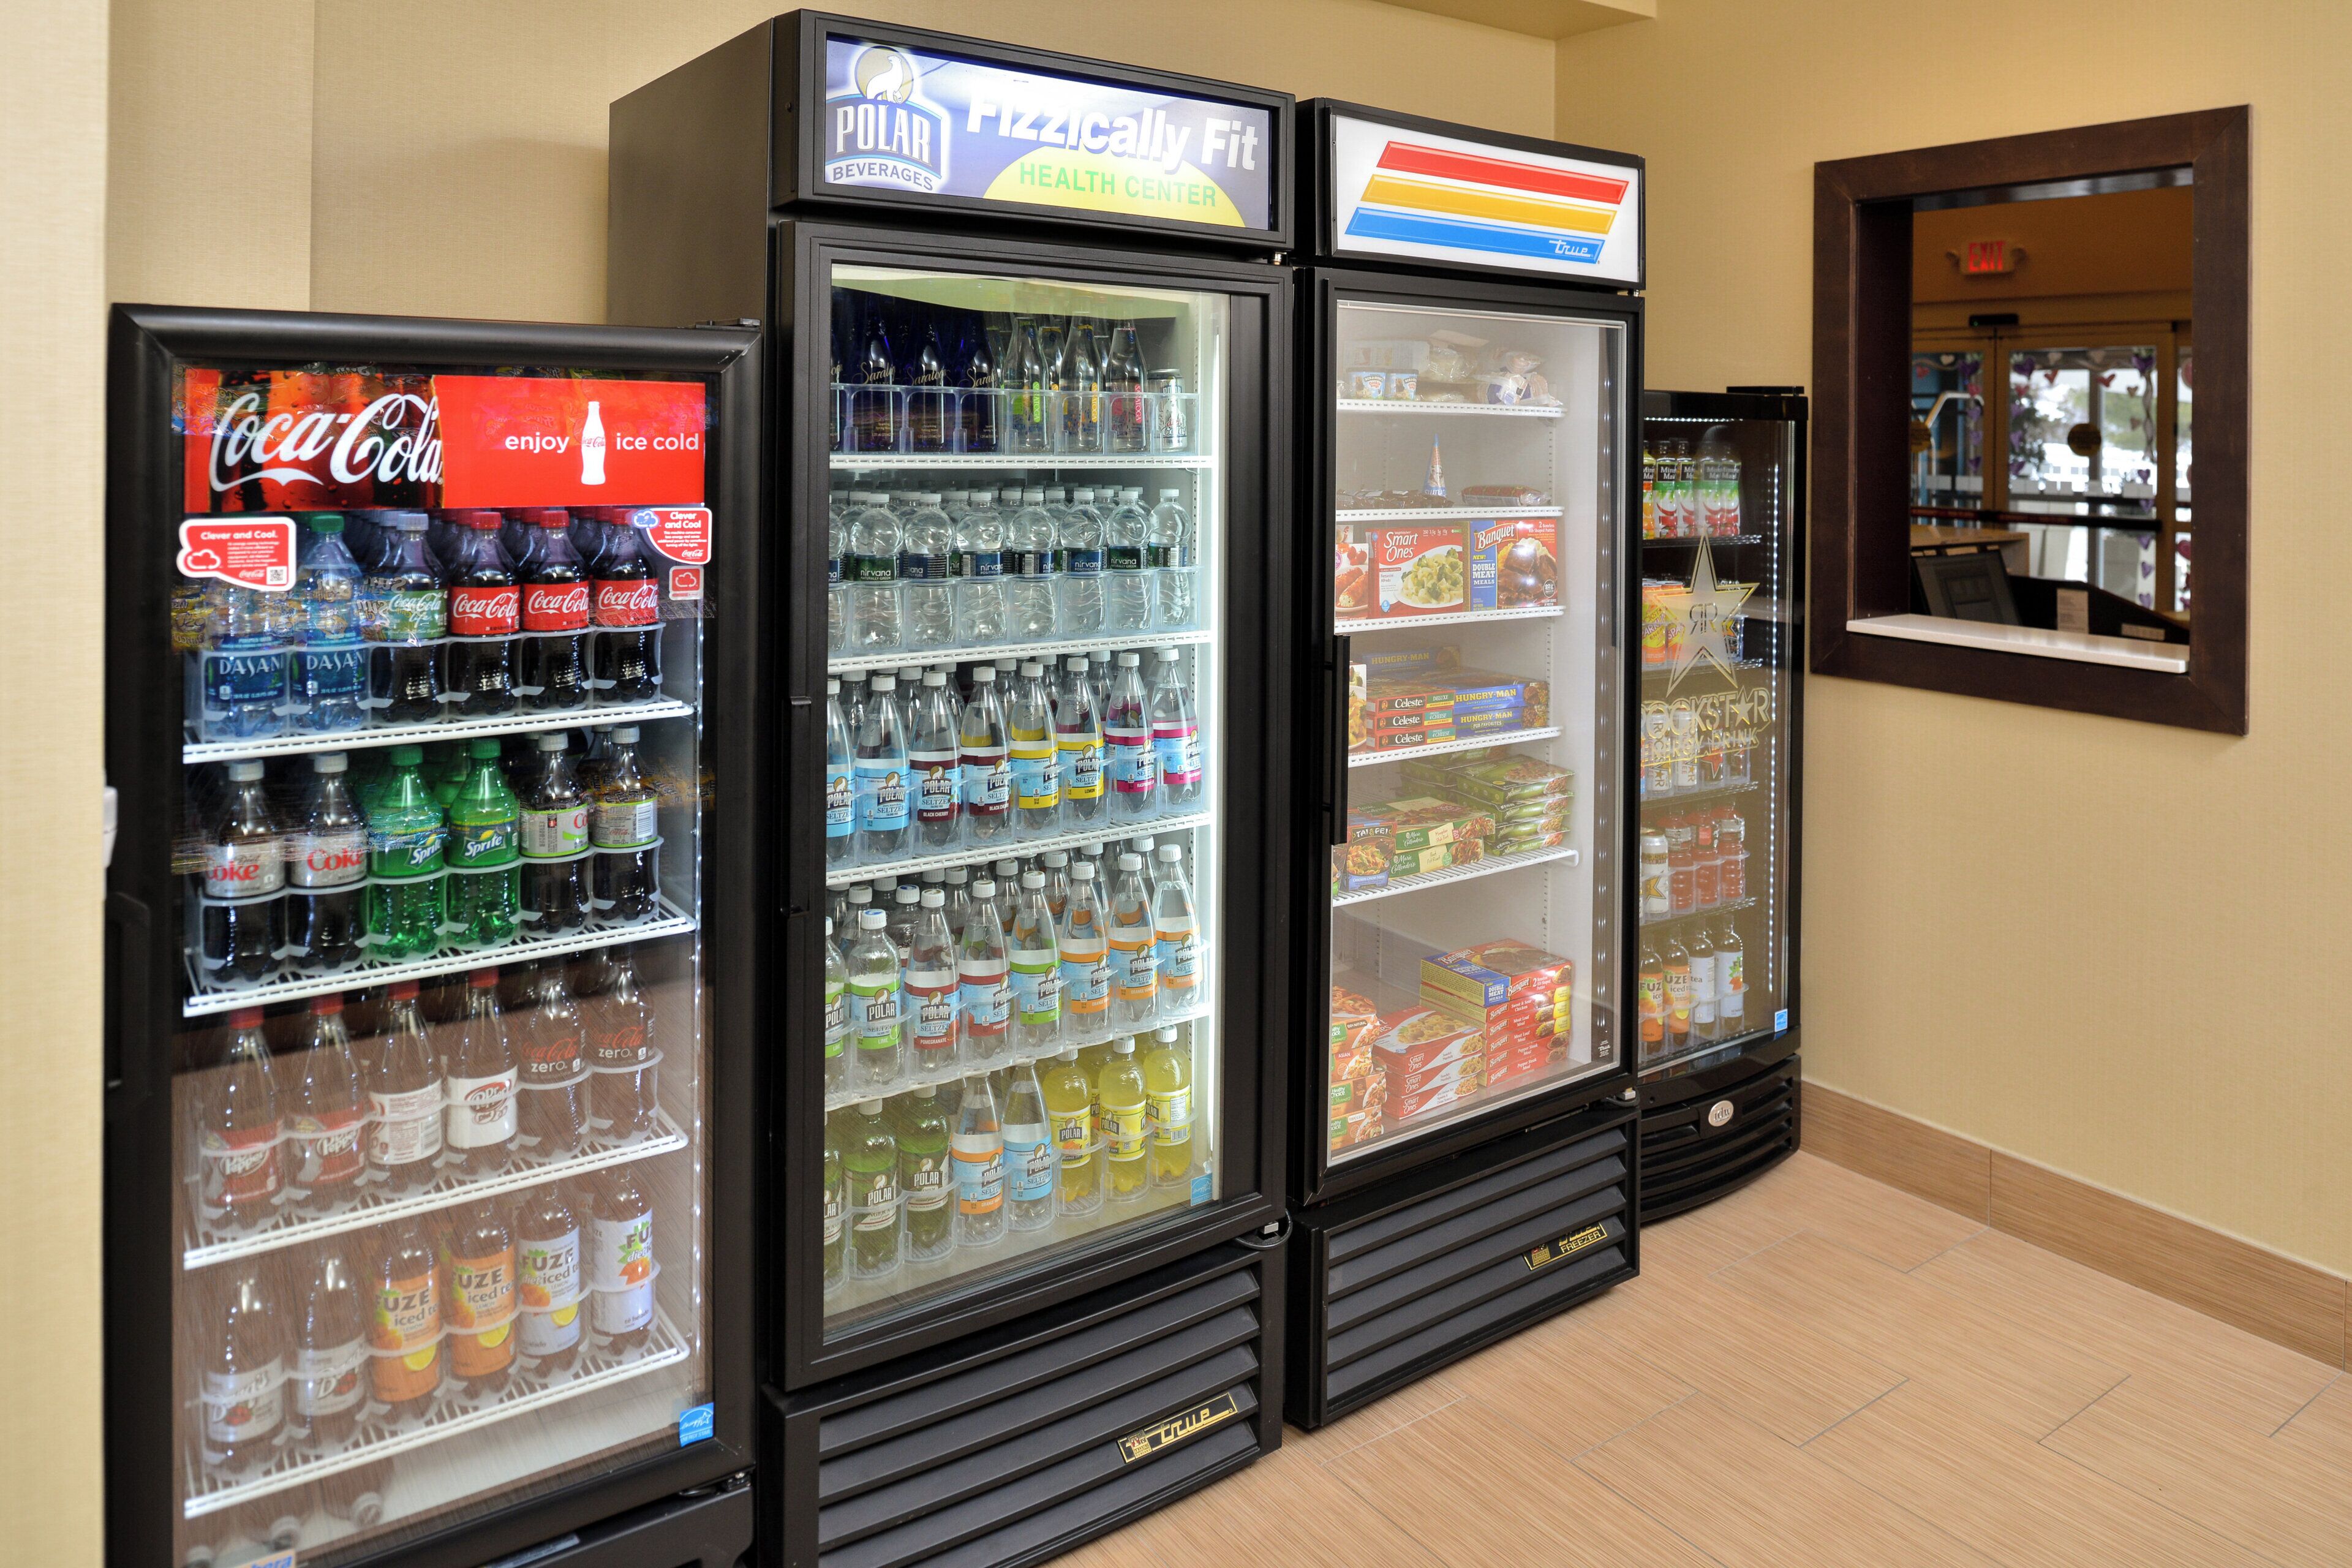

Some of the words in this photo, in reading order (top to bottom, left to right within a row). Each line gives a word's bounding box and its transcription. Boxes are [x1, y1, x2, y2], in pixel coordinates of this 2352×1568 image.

[834, 100, 932, 168] POLAR
[967, 96, 1190, 175] Fizzically
[1200, 118, 1259, 172] Fit
[831, 160, 934, 193] BEVERAGES
[1019, 162, 1118, 197] HEALTH
[1125, 175, 1218, 208] CENTER
[1549, 239, 1591, 258] true
[1969, 240, 2005, 273] EXIT
[209, 393, 442, 492] Coca-Cola
[505, 432, 570, 454] enjoy
[616, 432, 647, 451] ice
[653, 432, 699, 451] cold
[665, 520, 682, 529] and
[200, 531, 231, 540] Clever
[233, 530, 252, 540] and
[254, 530, 278, 539] Cool.
[1384, 531, 1419, 549] Smart
[1477, 524, 1515, 550] Banquet
[1110, 556, 1137, 565] nirvana
[1386, 546, 1414, 562] Ones
[860, 568, 891, 577] nirvana
[1472, 570, 1496, 579] MEAT
[388, 591, 443, 612] Coca-Cola
[453, 589, 519, 619] Coca-Cola
[527, 583, 589, 614] Coca-Cola
[598, 584, 658, 611] Coca-Cola
[1395, 698, 1423, 709] Celeste
[1455, 688, 1517, 703] HUNGRY-MAN
[1393, 715, 1420, 726] Celeste
[1461, 711, 1513, 723] HUNGRY-MAN
[1395, 734, 1423, 744] Celeste
[924, 780, 950, 794] POLAR
[1355, 828, 1369, 838] TAI
[464, 832, 503, 858] Sprite
[1398, 855, 1412, 864] Marie
[1391, 862, 1416, 874] Callender's
[1488, 989, 1504, 998] MEAT
[1507, 978, 1530, 997] Banquet
[1532, 978, 1537, 987] 2
[869, 1002, 895, 1020] POLAR
[921, 1006, 949, 1021] POLAR
[1489, 1004, 1508, 1020] Banquet
[920, 1023, 950, 1032] SELTZER
[1489, 1020, 1508, 1036] Banquet
[1490, 1035, 1508, 1052] Banquet
[598, 1048, 631, 1058] zero
[1408, 1054, 1425, 1066] Smart
[1489, 1050, 1508, 1068] Banquet
[531, 1061, 566, 1072] zero
[1409, 1061, 1422, 1072] Ones
[1404, 1076, 1422, 1087] Smart
[1490, 1066, 1508, 1084] Banquet
[1406, 1084, 1419, 1093] Ones
[1403, 1096, 1419, 1108] Smart
[1403, 1104, 1417, 1114] Ones
[1101, 1117, 1118, 1133] POLAR
[1061, 1127, 1081, 1140] POLAR
[914, 1170, 940, 1187] POLAR
[867, 1187, 892, 1206] POLAR
[1559, 1230, 1601, 1254] FREEZER
[522, 1248, 574, 1272] FUZE
[543, 1270, 570, 1285] iced
[467, 1289, 498, 1305] iced
[394, 1308, 424, 1327] iced
